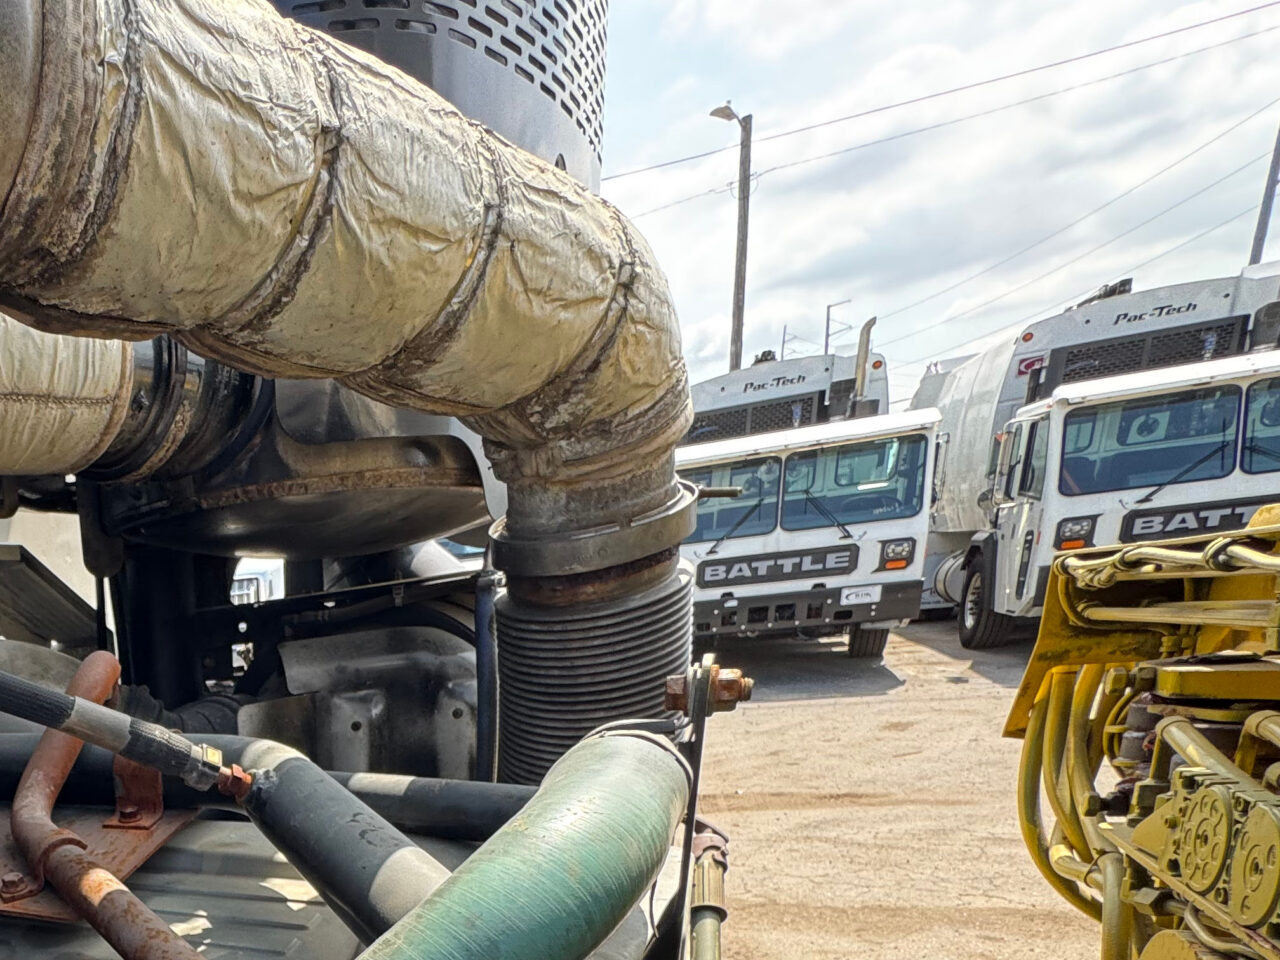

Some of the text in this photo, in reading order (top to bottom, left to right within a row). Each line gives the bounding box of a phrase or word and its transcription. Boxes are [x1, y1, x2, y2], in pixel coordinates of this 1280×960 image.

[1112, 302, 1197, 326] Pac-Tech
[743, 375, 806, 393] Pac-Tech
[704, 551, 851, 582] BATTLE
